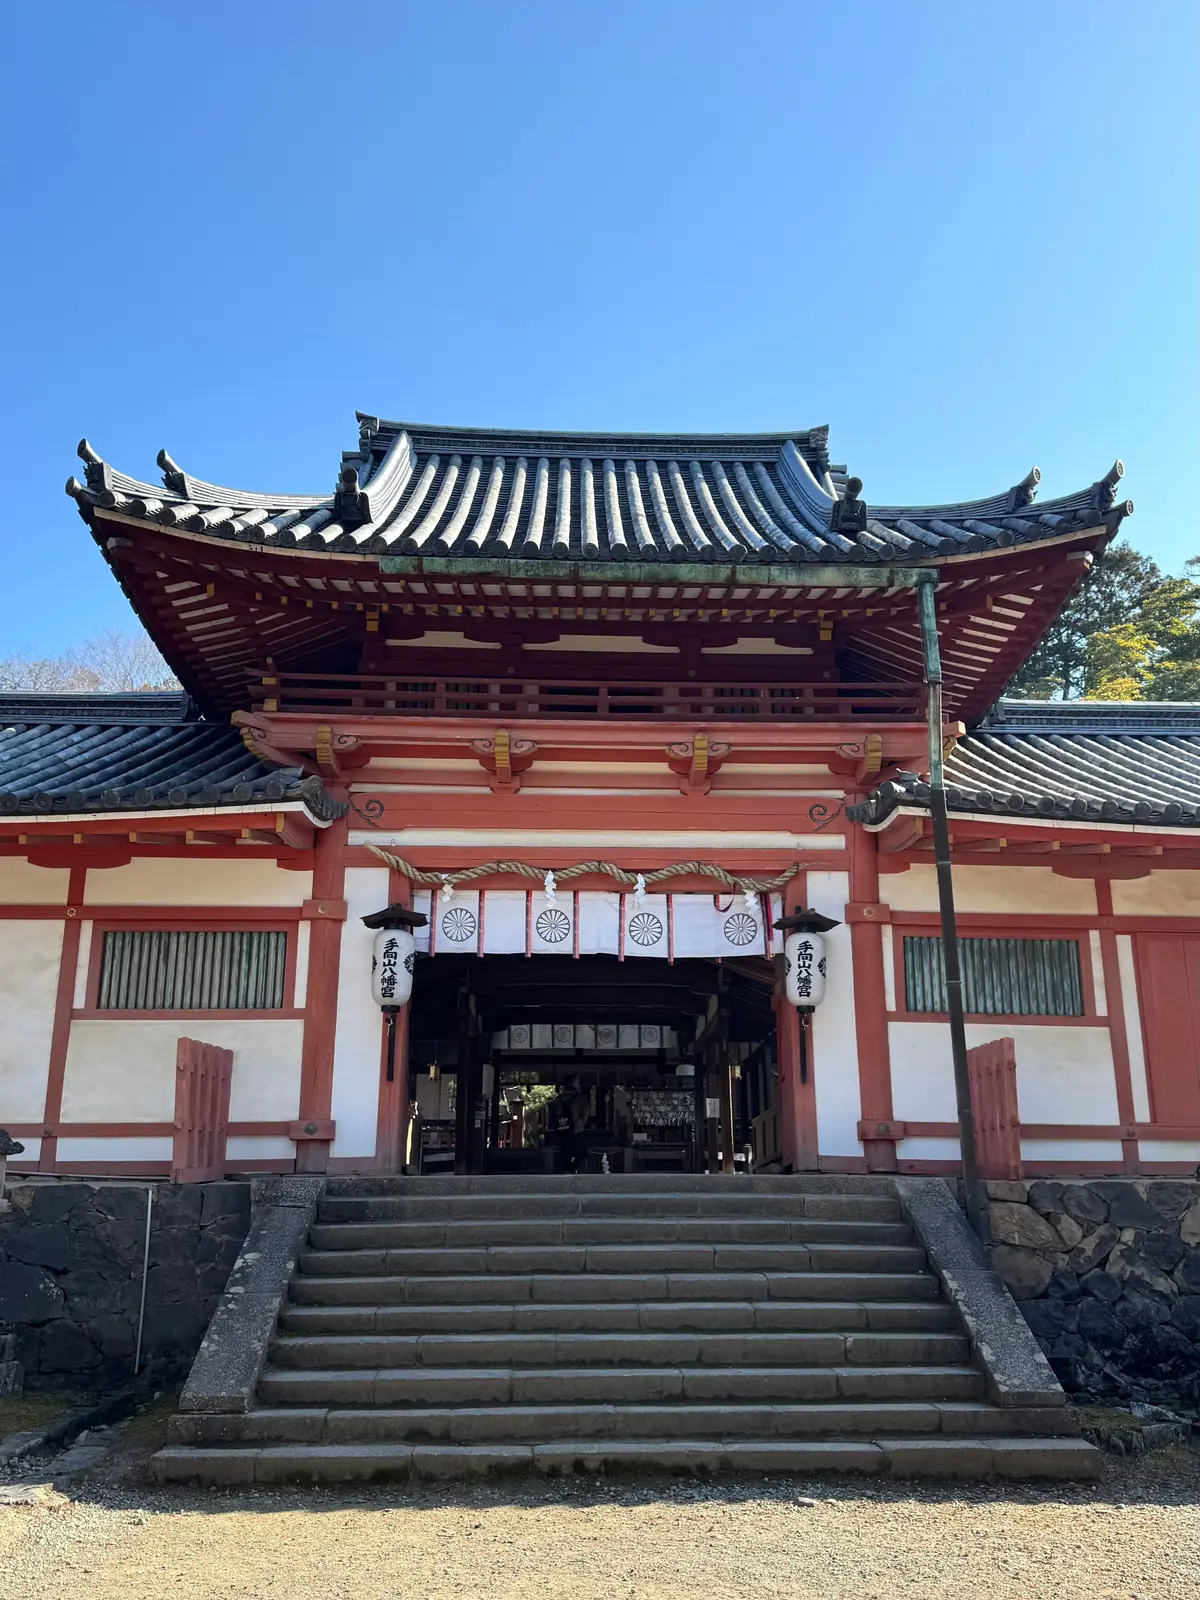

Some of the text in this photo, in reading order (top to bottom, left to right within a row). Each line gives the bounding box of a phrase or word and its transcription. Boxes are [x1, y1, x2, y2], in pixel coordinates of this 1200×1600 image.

[380, 937, 400, 999] 手向山八幡宮
[796, 940, 814, 998] 手向山八幡宮
